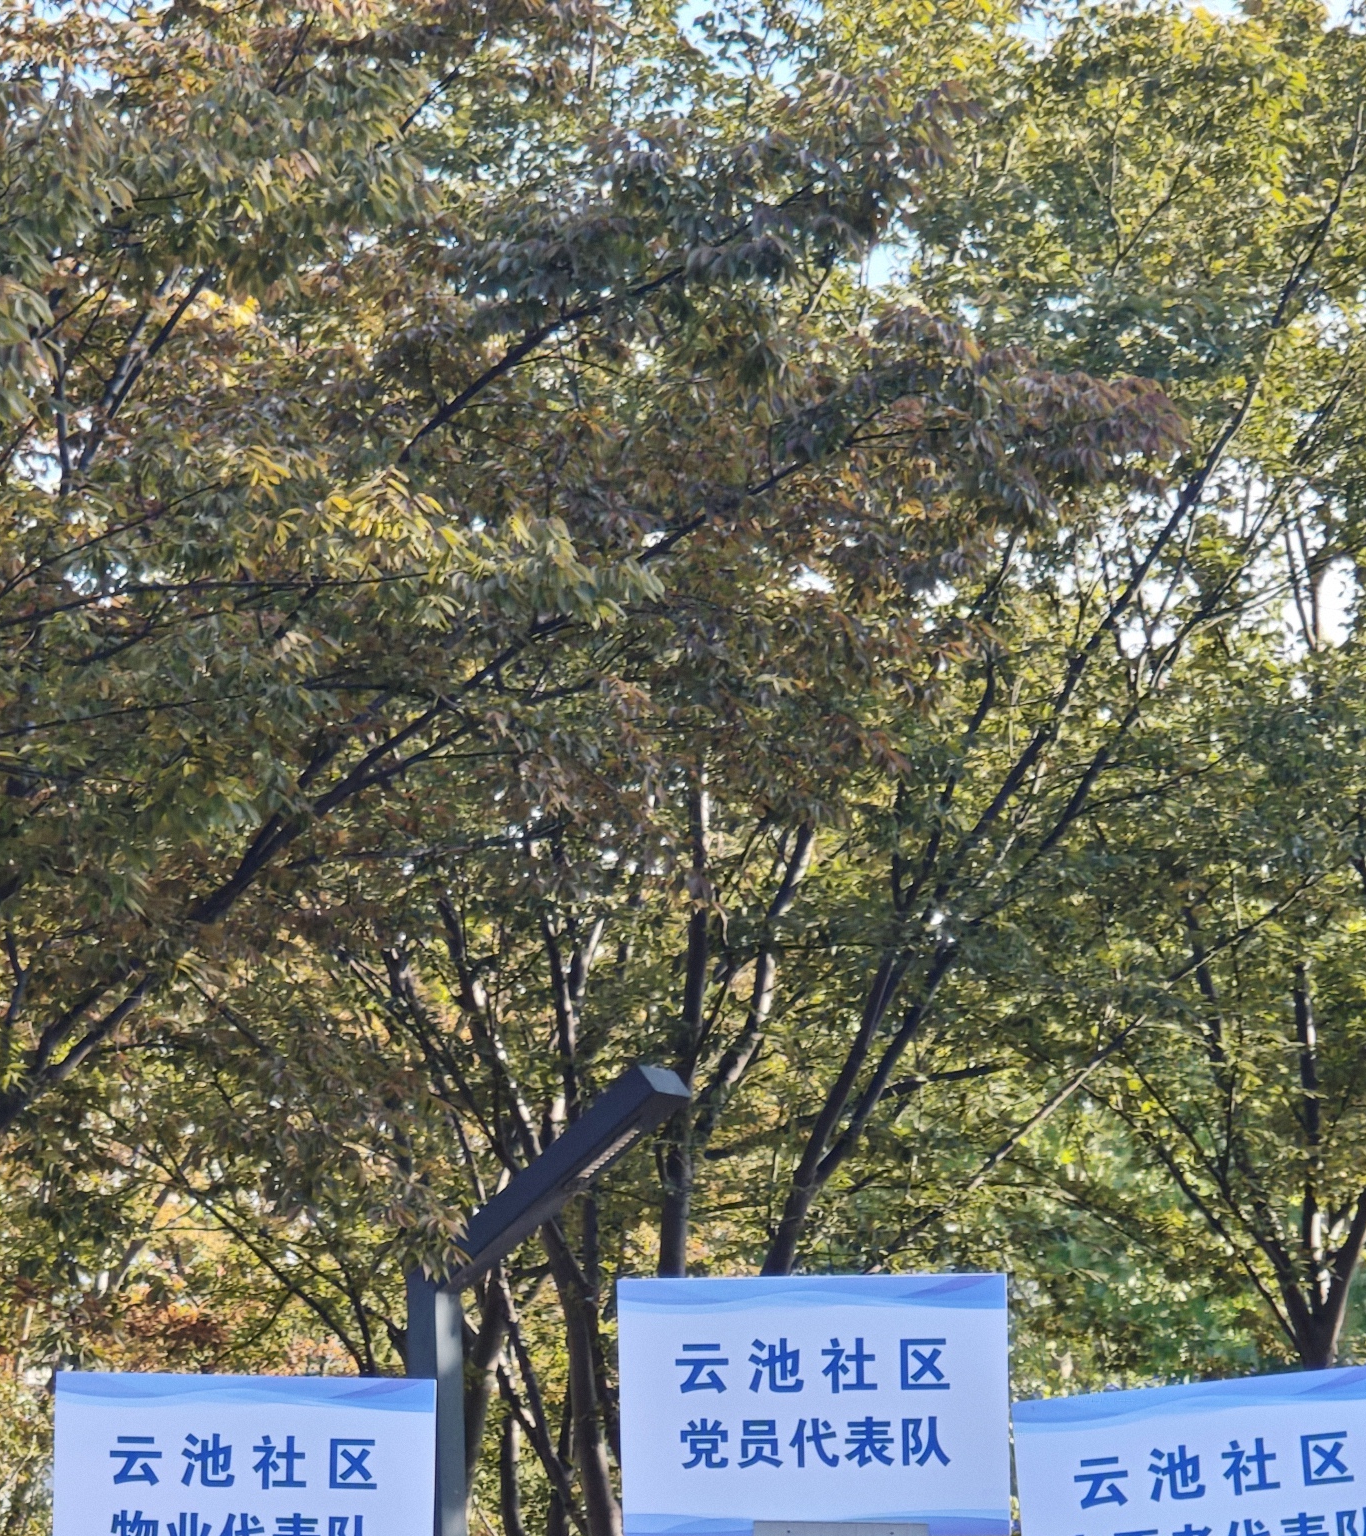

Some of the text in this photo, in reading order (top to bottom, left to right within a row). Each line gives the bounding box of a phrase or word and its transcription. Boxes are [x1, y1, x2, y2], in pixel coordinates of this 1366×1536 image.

[675, 1338, 950, 1393] 云池社区
[110, 1433, 377, 1489] 云池社区
[680, 1416, 950, 1469] 党员代表队
[1073, 1431, 1354, 1508] 云池社区
